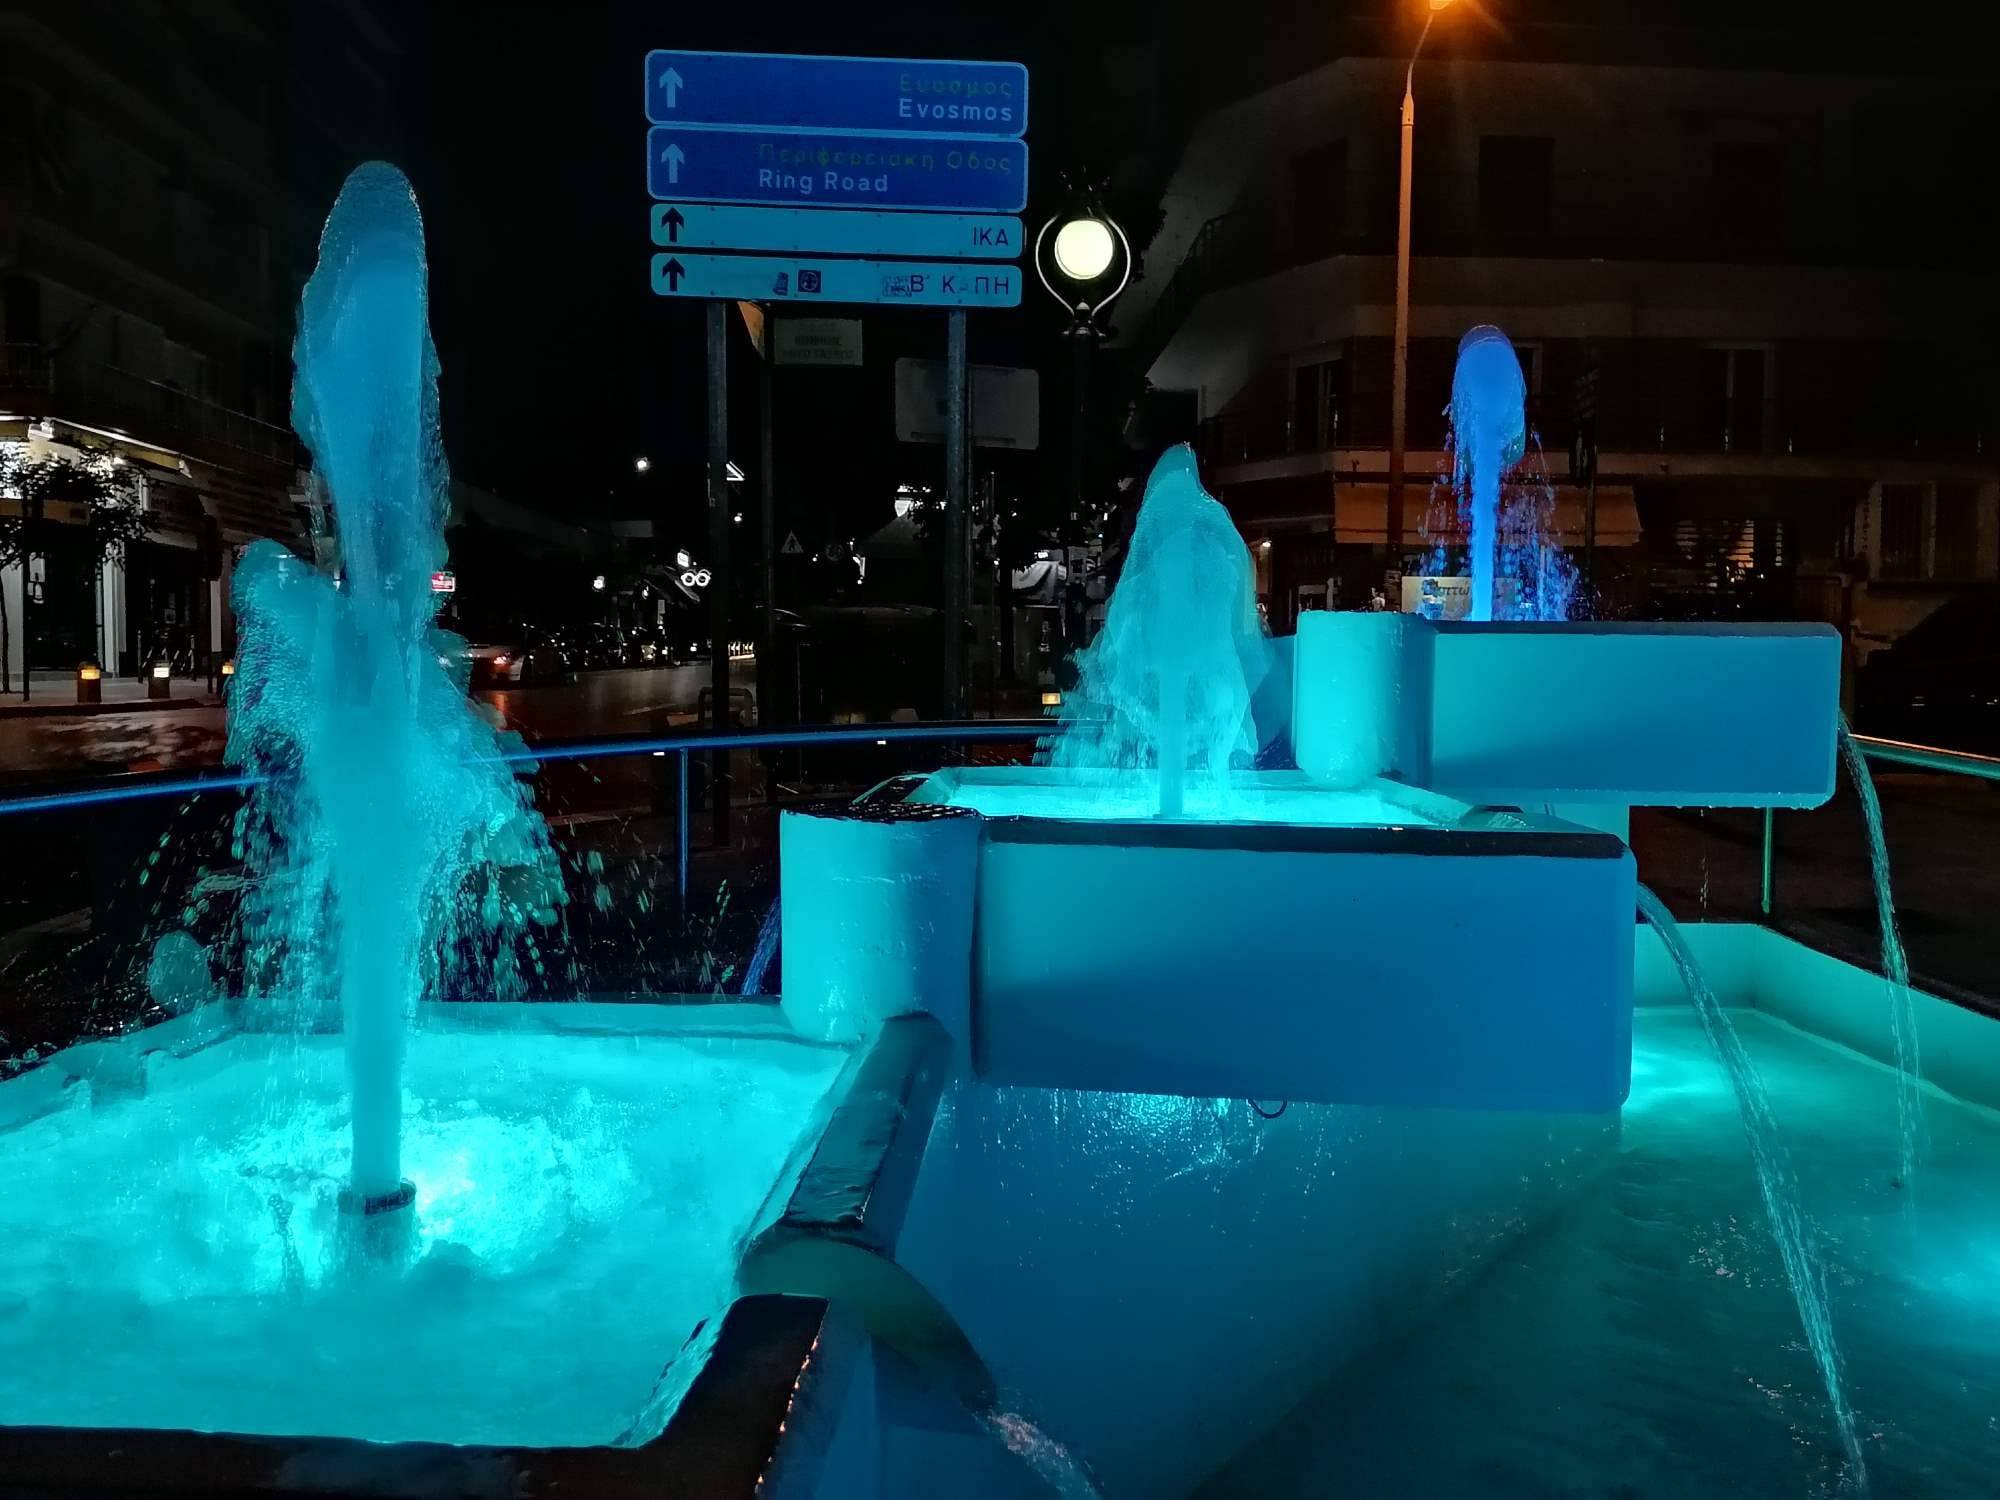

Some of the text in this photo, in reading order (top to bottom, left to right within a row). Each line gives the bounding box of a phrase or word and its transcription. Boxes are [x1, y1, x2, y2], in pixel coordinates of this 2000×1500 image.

[899, 98, 1013, 121] Evosmos
[759, 168, 888, 195] Ring Road
